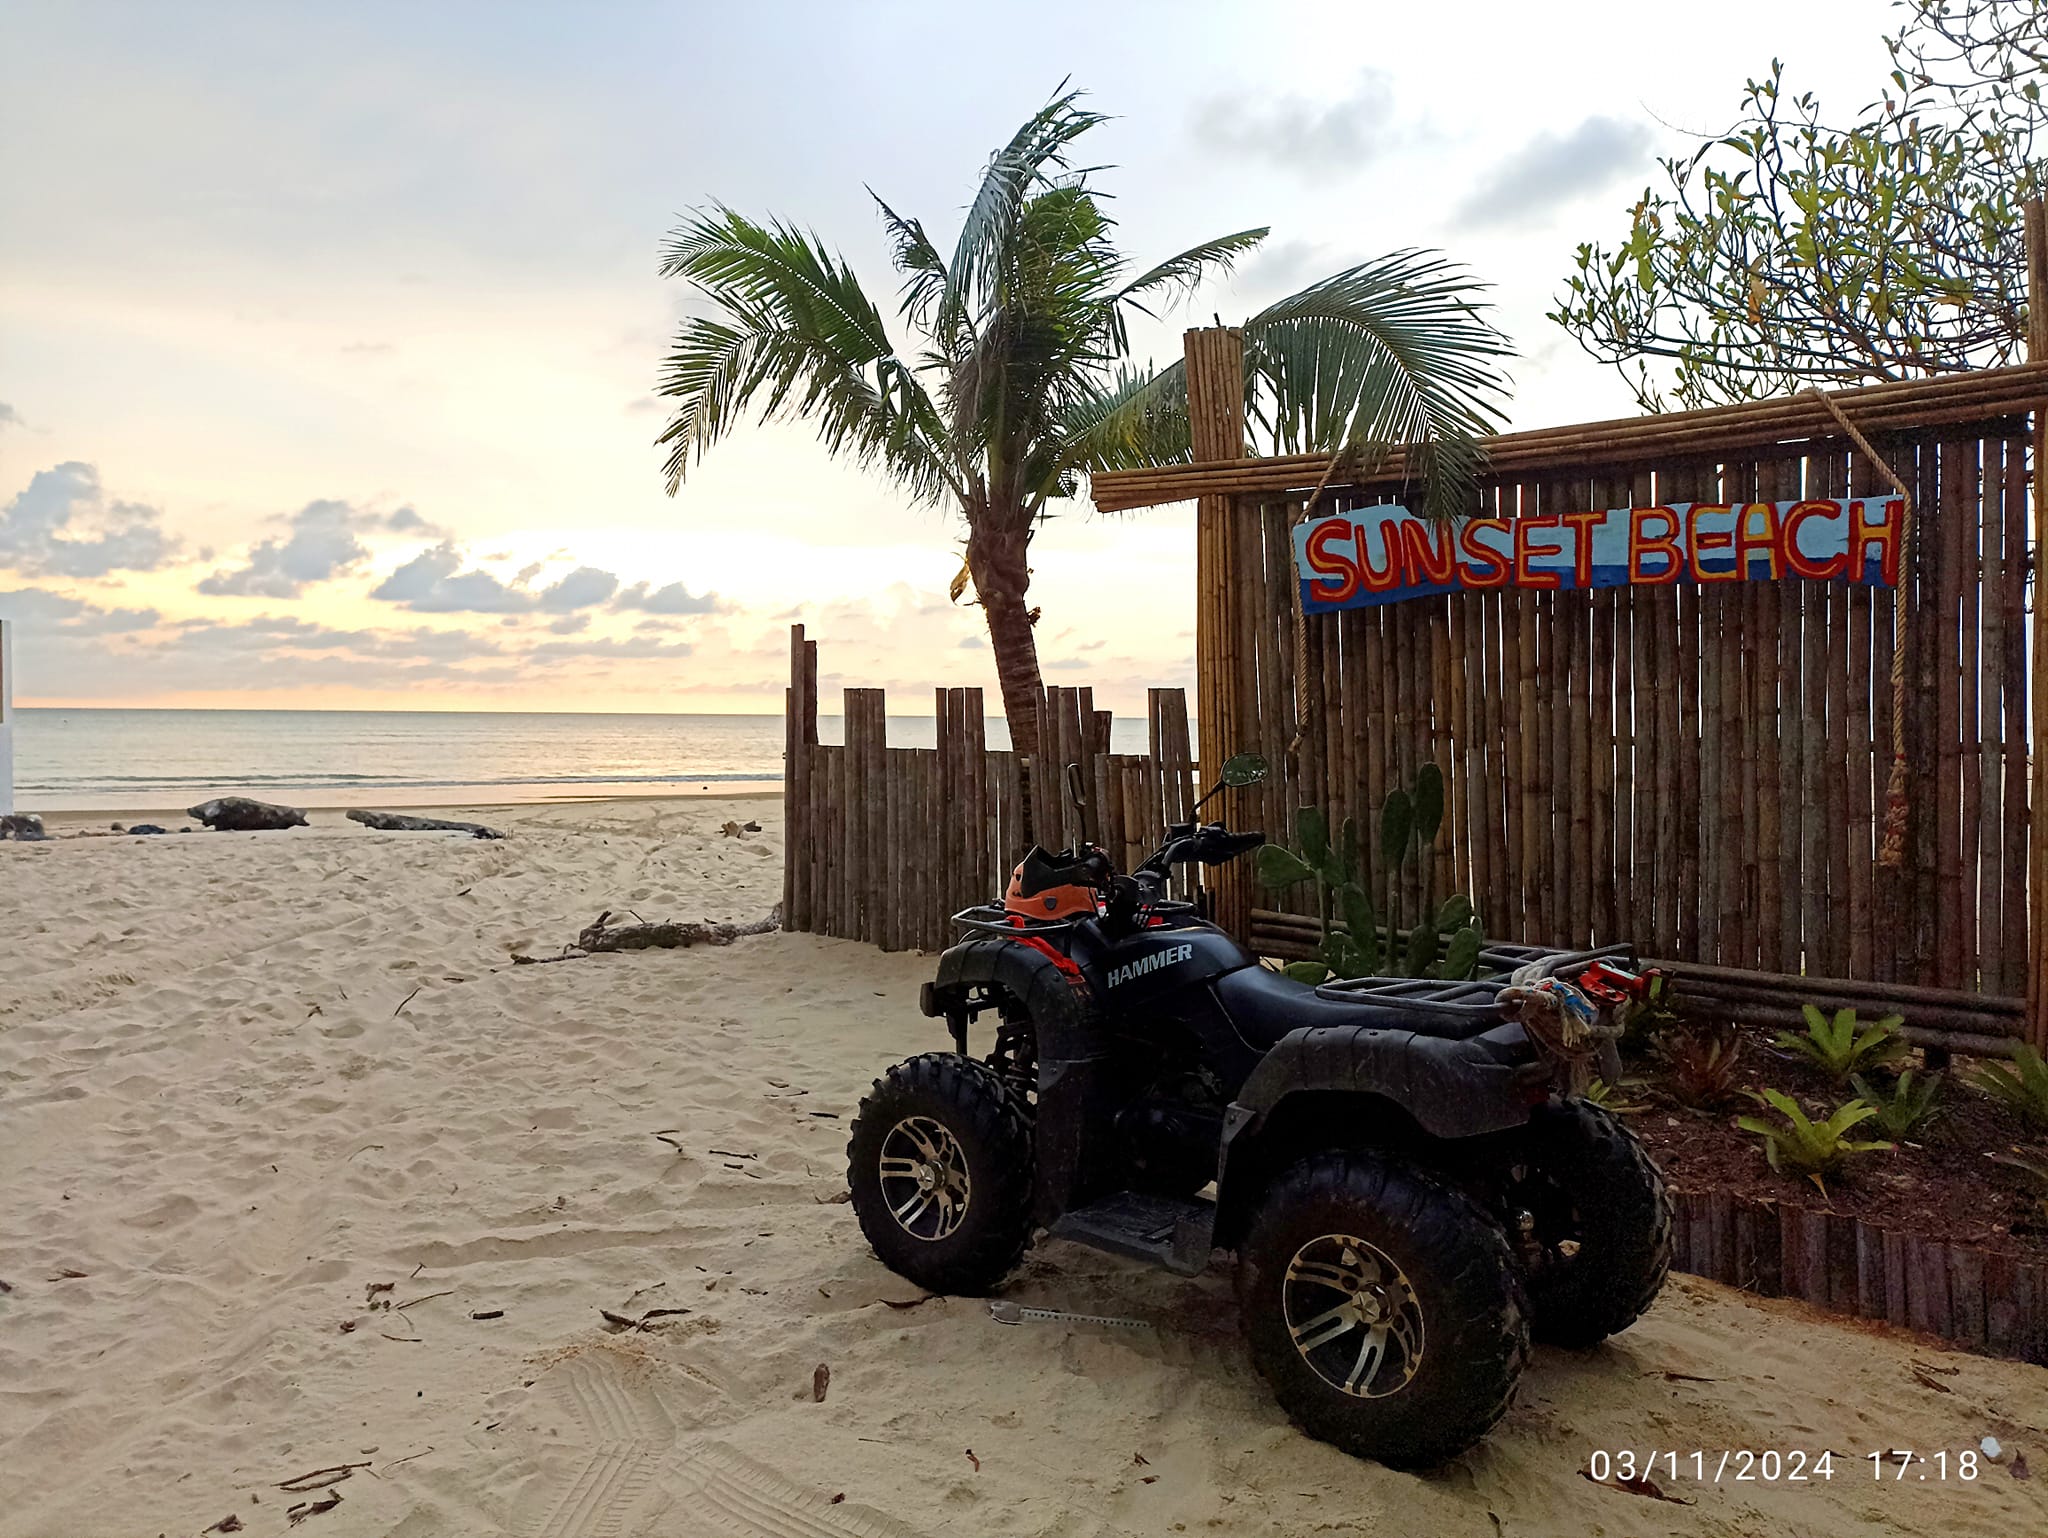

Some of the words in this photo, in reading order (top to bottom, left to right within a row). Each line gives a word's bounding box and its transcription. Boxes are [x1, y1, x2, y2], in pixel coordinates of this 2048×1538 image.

[1306, 513, 1606, 600] SUNSET
[1628, 500, 1900, 586] BEACH
[1107, 943, 1192, 988] HAMMER
